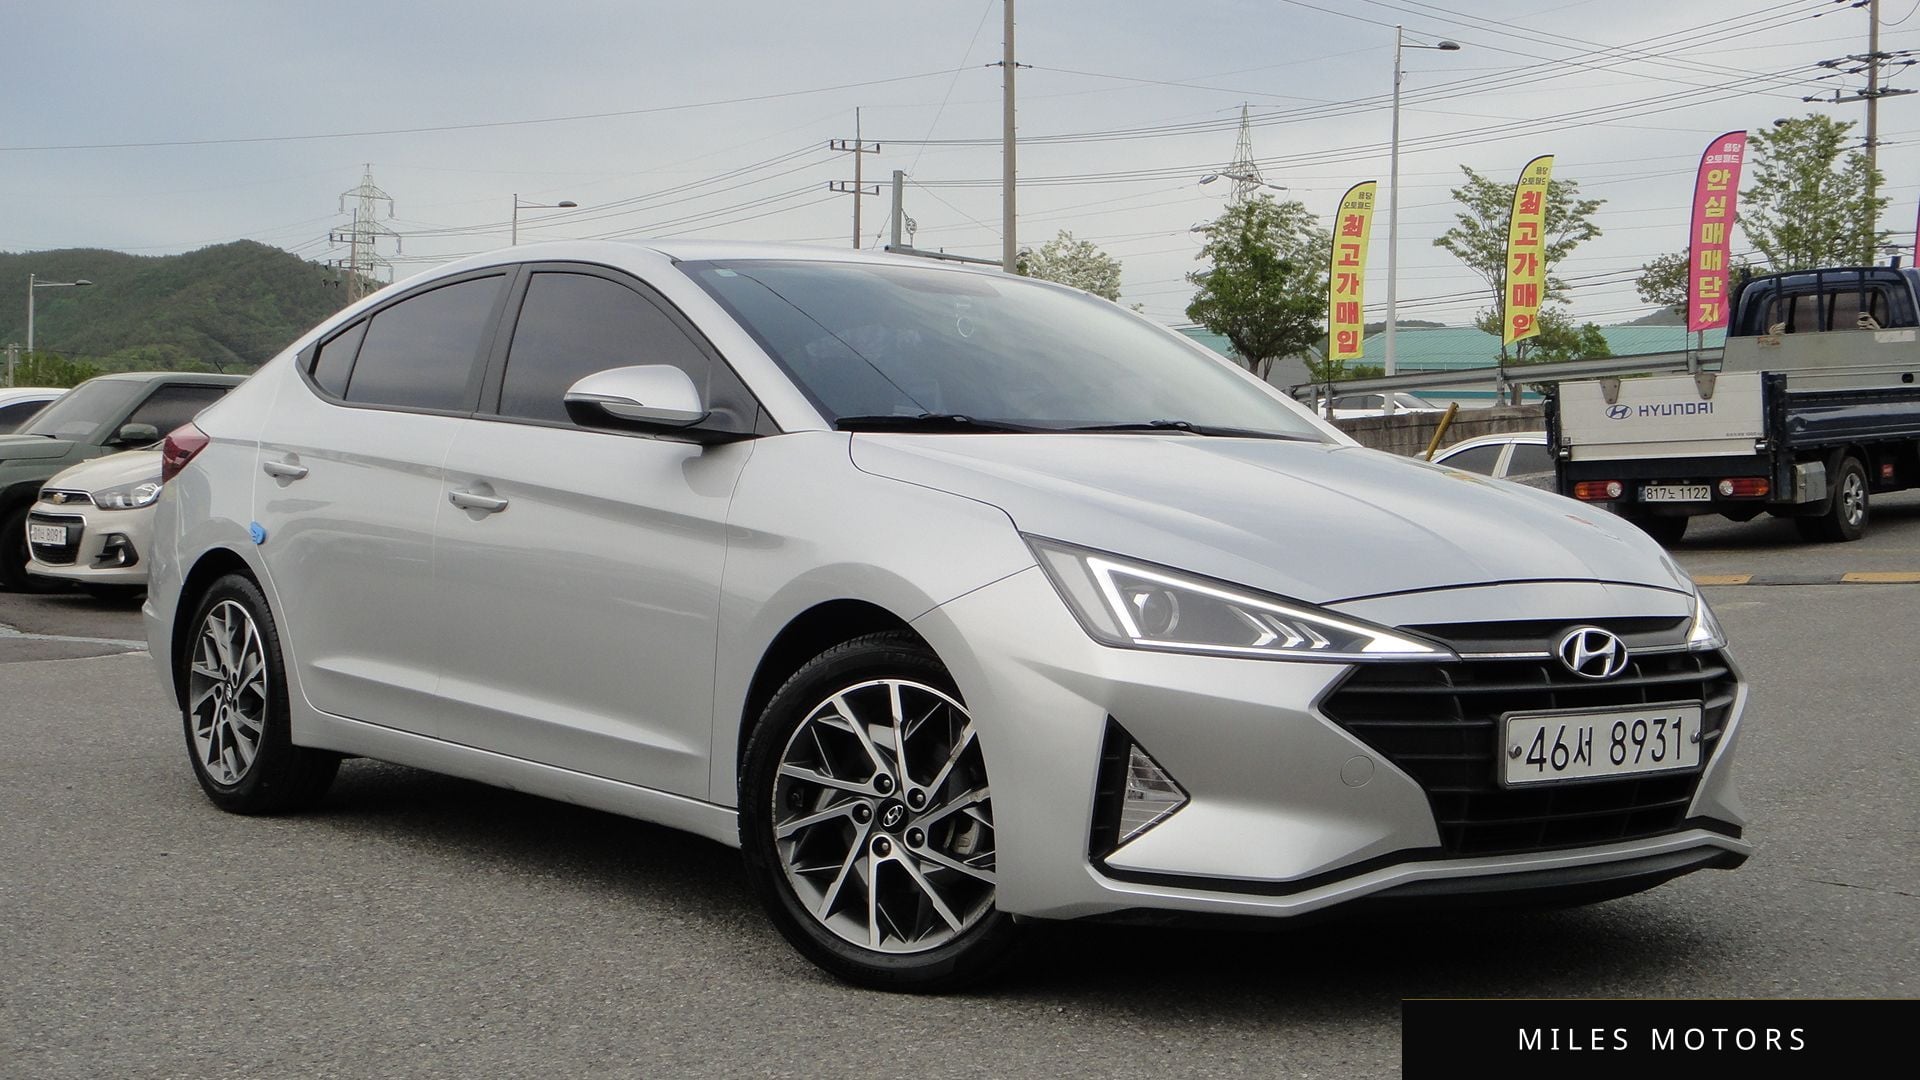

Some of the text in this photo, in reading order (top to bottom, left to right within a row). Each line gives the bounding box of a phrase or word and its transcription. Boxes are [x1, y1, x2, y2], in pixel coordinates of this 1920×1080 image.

[1336, 214, 1365, 354] 최고가매입
[1638, 402, 1714, 417] HYUNDAI
[1679, 486, 1708, 499] 1122
[1525, 716, 1683, 772] 46서 8931
